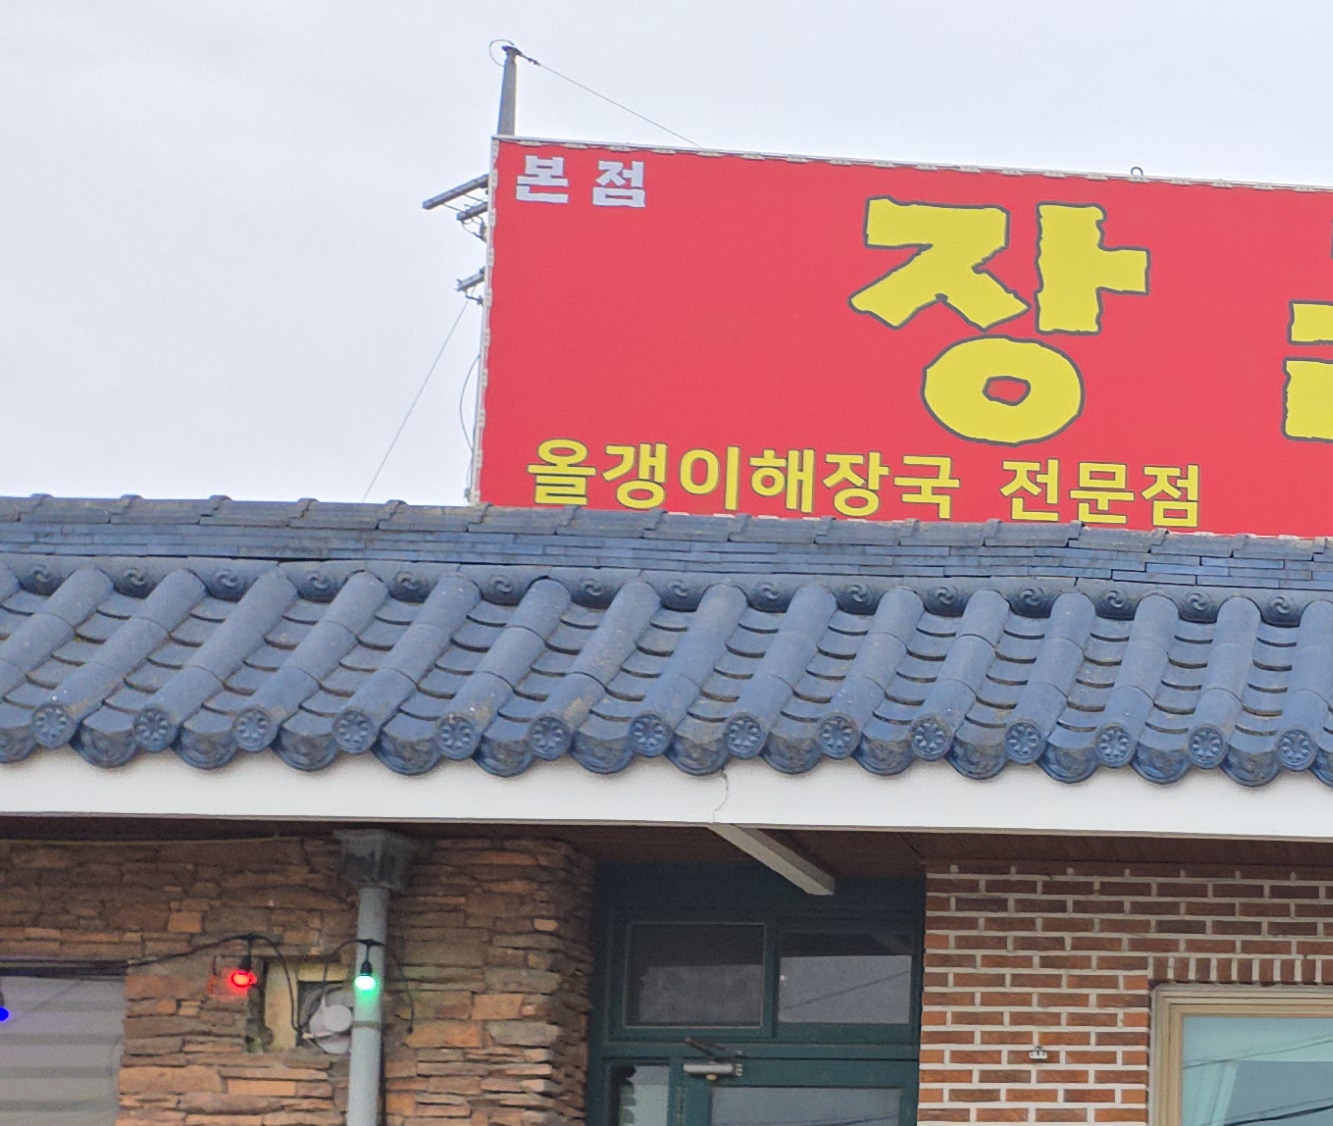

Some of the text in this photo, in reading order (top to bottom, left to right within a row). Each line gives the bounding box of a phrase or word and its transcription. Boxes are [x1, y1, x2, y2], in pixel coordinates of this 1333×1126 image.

[515, 154, 647, 208] 본점
[527, 437, 1200, 529] 올갱이해장국 전문점
